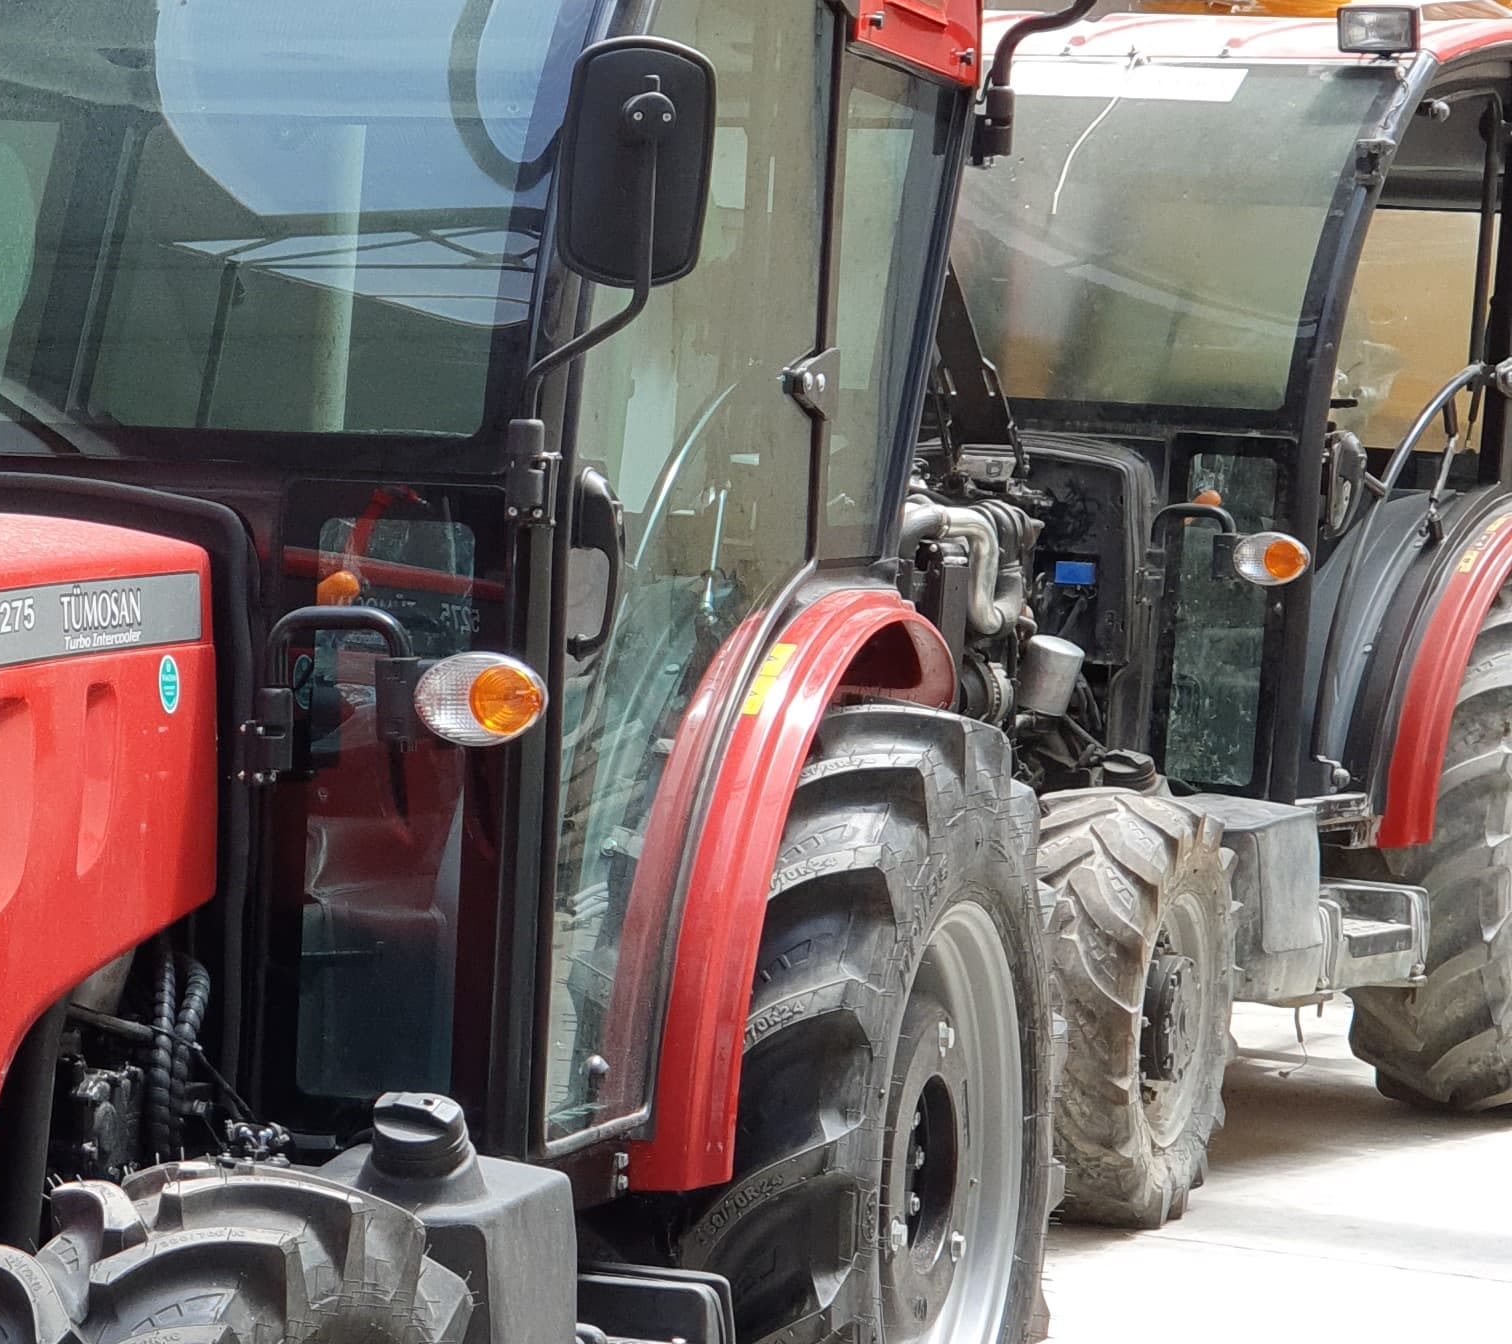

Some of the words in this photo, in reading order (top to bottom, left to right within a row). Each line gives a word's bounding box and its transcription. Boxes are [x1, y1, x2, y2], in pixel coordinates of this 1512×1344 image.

[59, 585, 142, 632] TÜMOSAN
[64, 635, 91, 650] Turbo
[92, 629, 142, 647] Intercooler
